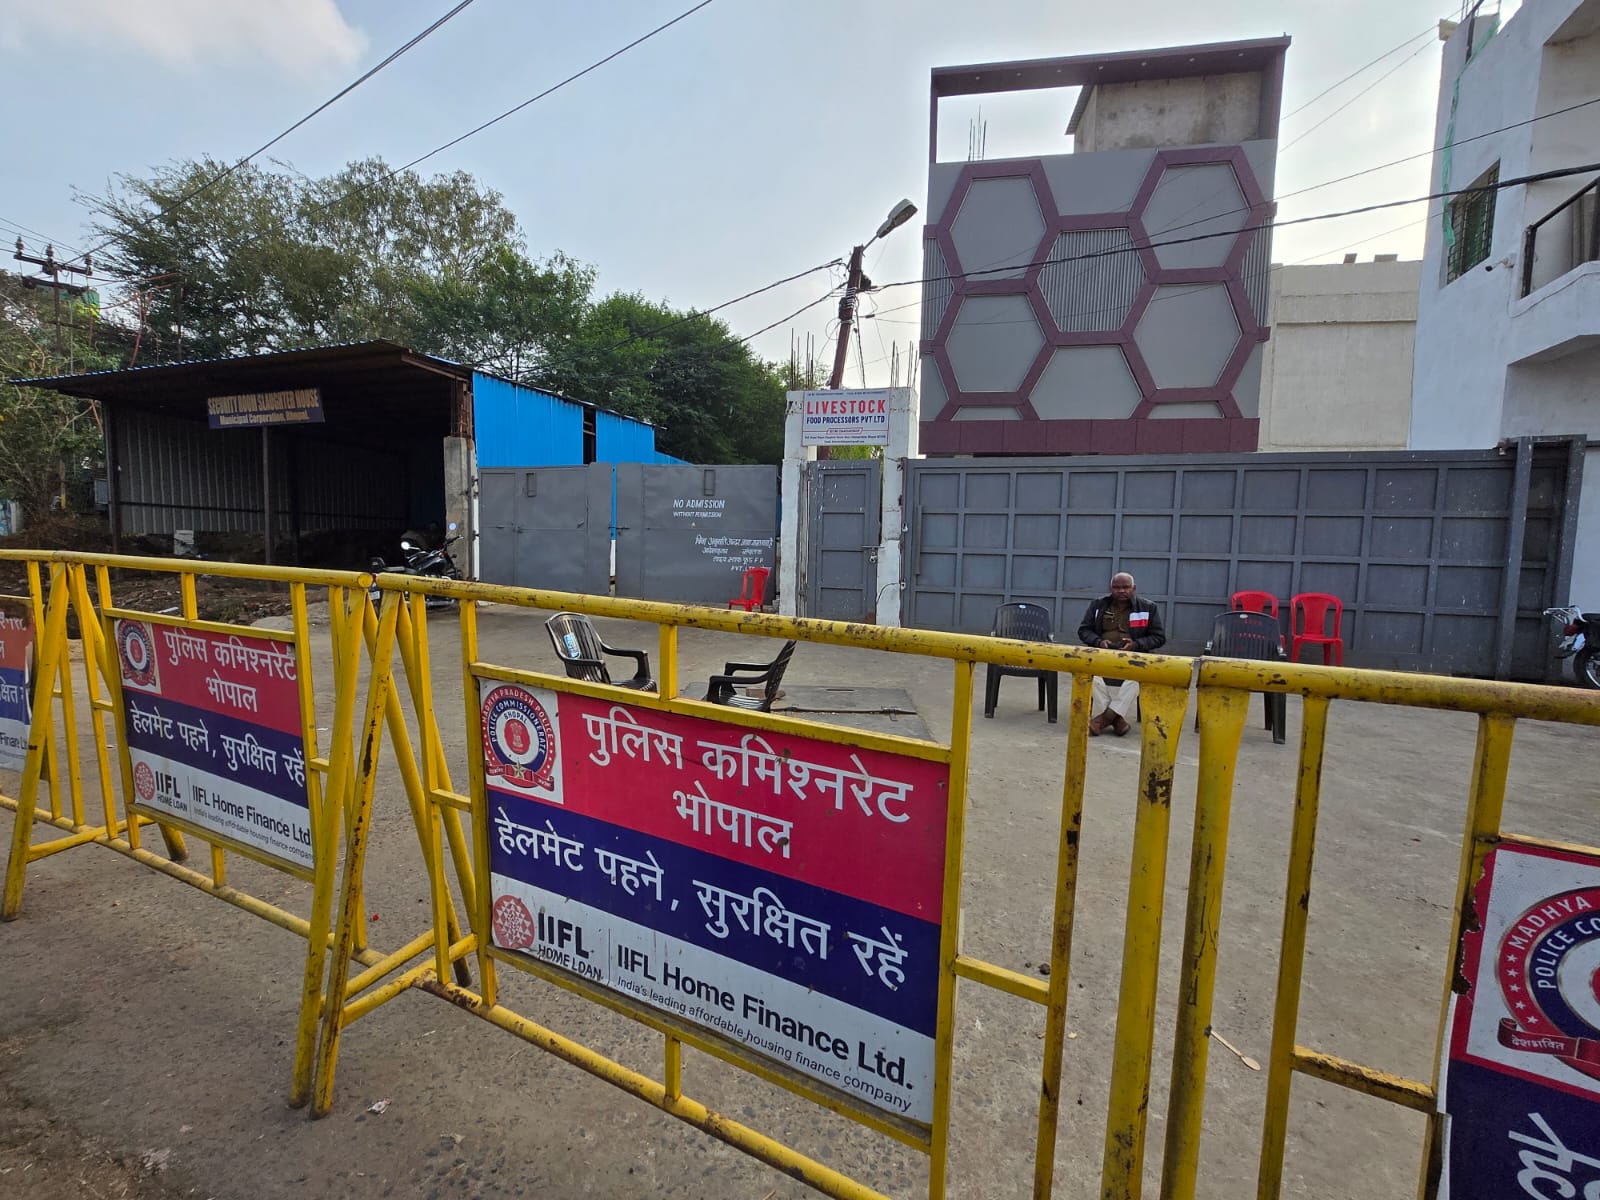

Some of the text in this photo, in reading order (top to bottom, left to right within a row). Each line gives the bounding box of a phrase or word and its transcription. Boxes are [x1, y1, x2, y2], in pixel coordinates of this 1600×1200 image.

[258, 390, 295, 411] SLAUGHTER
[296, 388, 319, 408] HOUSE
[807, 400, 886, 415] LIVESTOCK
[807, 415, 885, 424] FOOD PROCESSORS PVT LTD
[673, 499, 725, 509] NO ADMISSION
[695, 511, 722, 519] PERMISSION
[163, 627, 208, 666] पुलिस
[211, 635, 297, 681] कमिश्नरेट
[206, 669, 258, 712] भोपाल
[482, 689, 554, 739] MADHYA PRADESH POLICE
[489, 700, 545, 755] POLICE COMMISSIONERATE
[503, 711, 527, 724] BHOPAL
[130, 701, 174, 740] हेलमेट
[220, 733, 276, 775] सुरक्षित
[282, 747, 305, 787] रहें
[582, 706, 914, 823] पुलिस कमिश्नरेट
[155, 771, 181, 799] IIFL
[157, 795, 188, 812] HOME LOAN
[192, 785, 210, 806] IIFL
[212, 792, 243, 819] Home
[246, 805, 289, 837] Finance
[672, 780, 793, 859] भोपाल
[494, 806, 584, 872] हेलमेट
[692, 879, 831, 961] सुरक्षित
[847, 926, 909, 992] रहें
[1508, 896, 1593, 950] MADHYA
[538, 912, 589, 959] IIFL
[538, 944, 569, 967] HOME
[1535, 930, 1576, 989] POLICE
[617, 944, 914, 1090] IIFL Home Finance Ltd.
[617, 976, 912, 1112] India's leading affordable housing finance company
